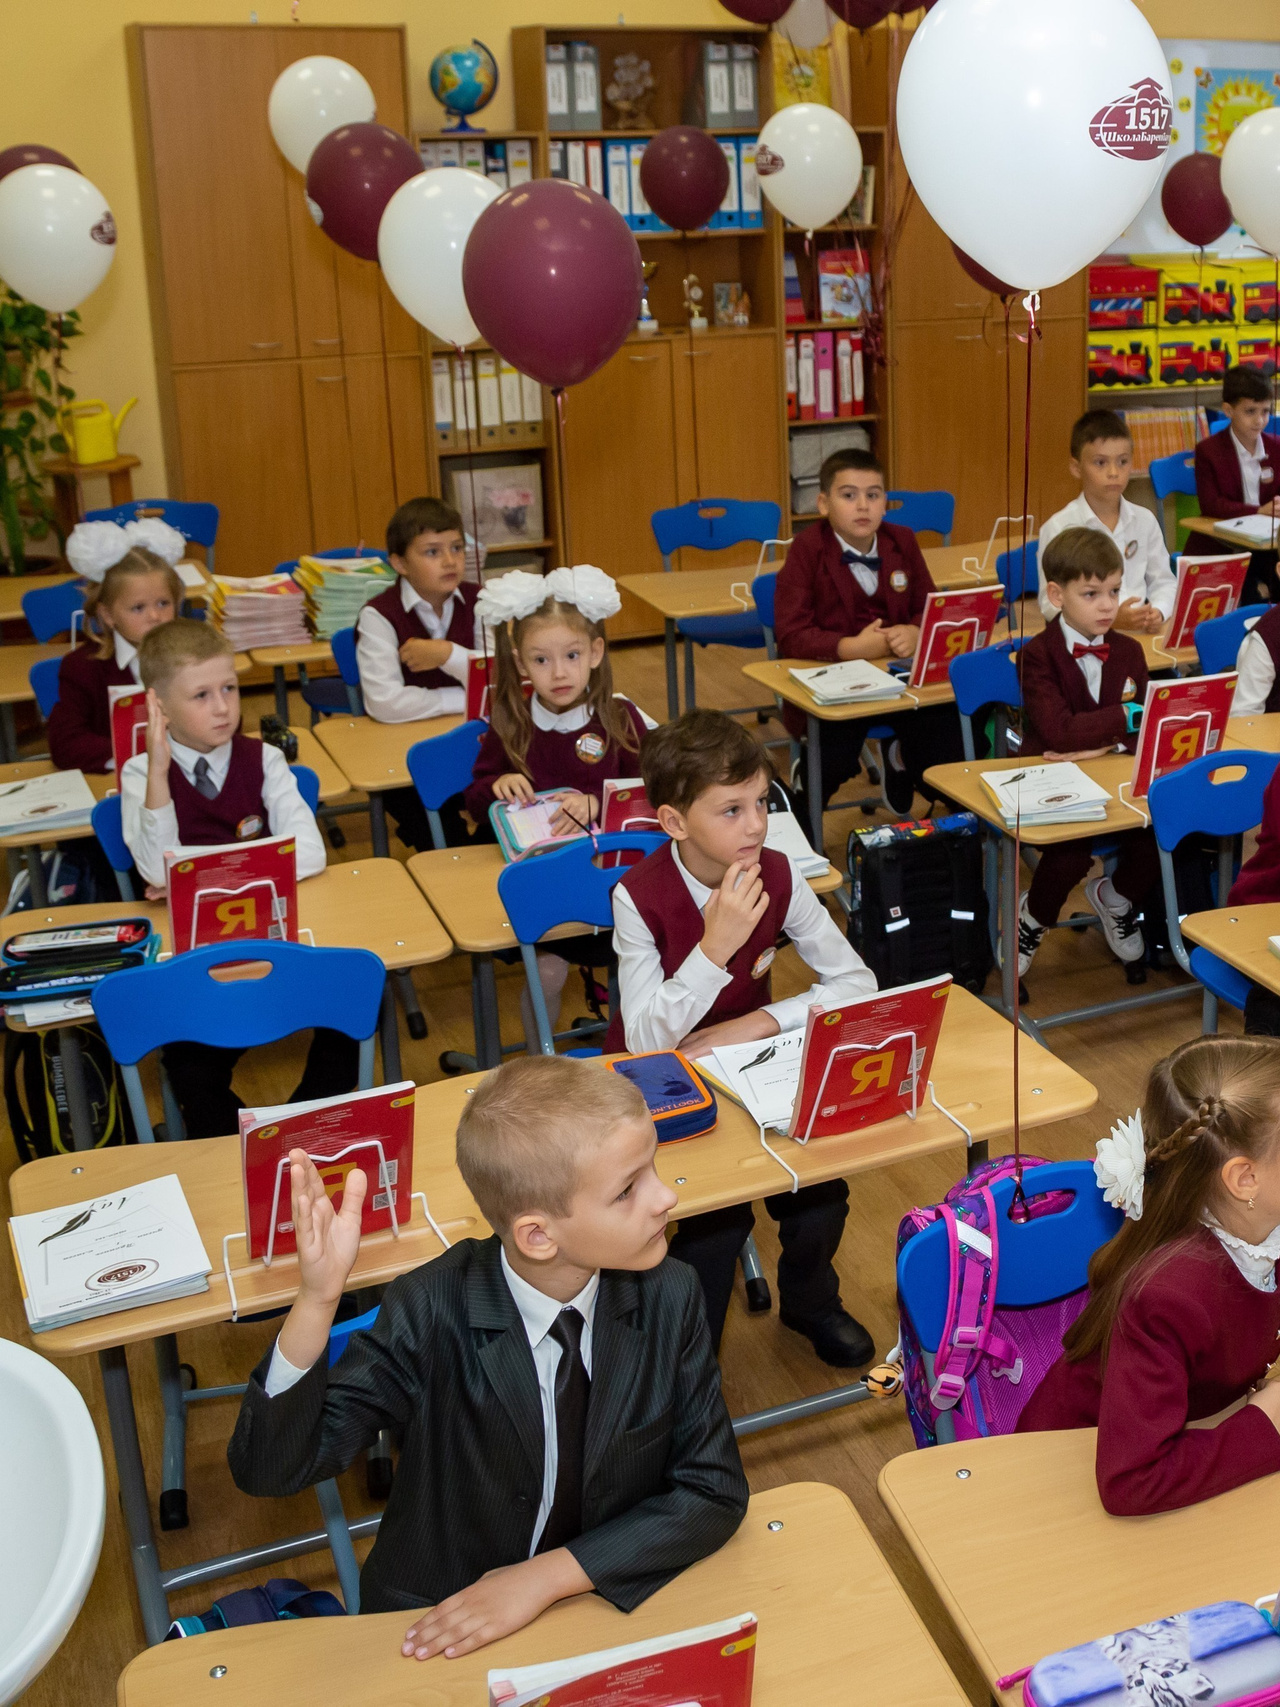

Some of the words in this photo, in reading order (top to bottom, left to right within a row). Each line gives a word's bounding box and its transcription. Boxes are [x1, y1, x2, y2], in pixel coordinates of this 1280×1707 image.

[1125, 107, 1168, 130] 1517
[1198, 597, 1220, 620] Я
[945, 630, 970, 657] Я
[1169, 727, 1200, 762] Я
[216, 897, 257, 935] Я
[850, 1050, 898, 1096] Я
[650, 1104, 672, 1115] ON'T
[673, 1098, 701, 1109] LOOK
[110, 1269, 134, 1280] 1517
